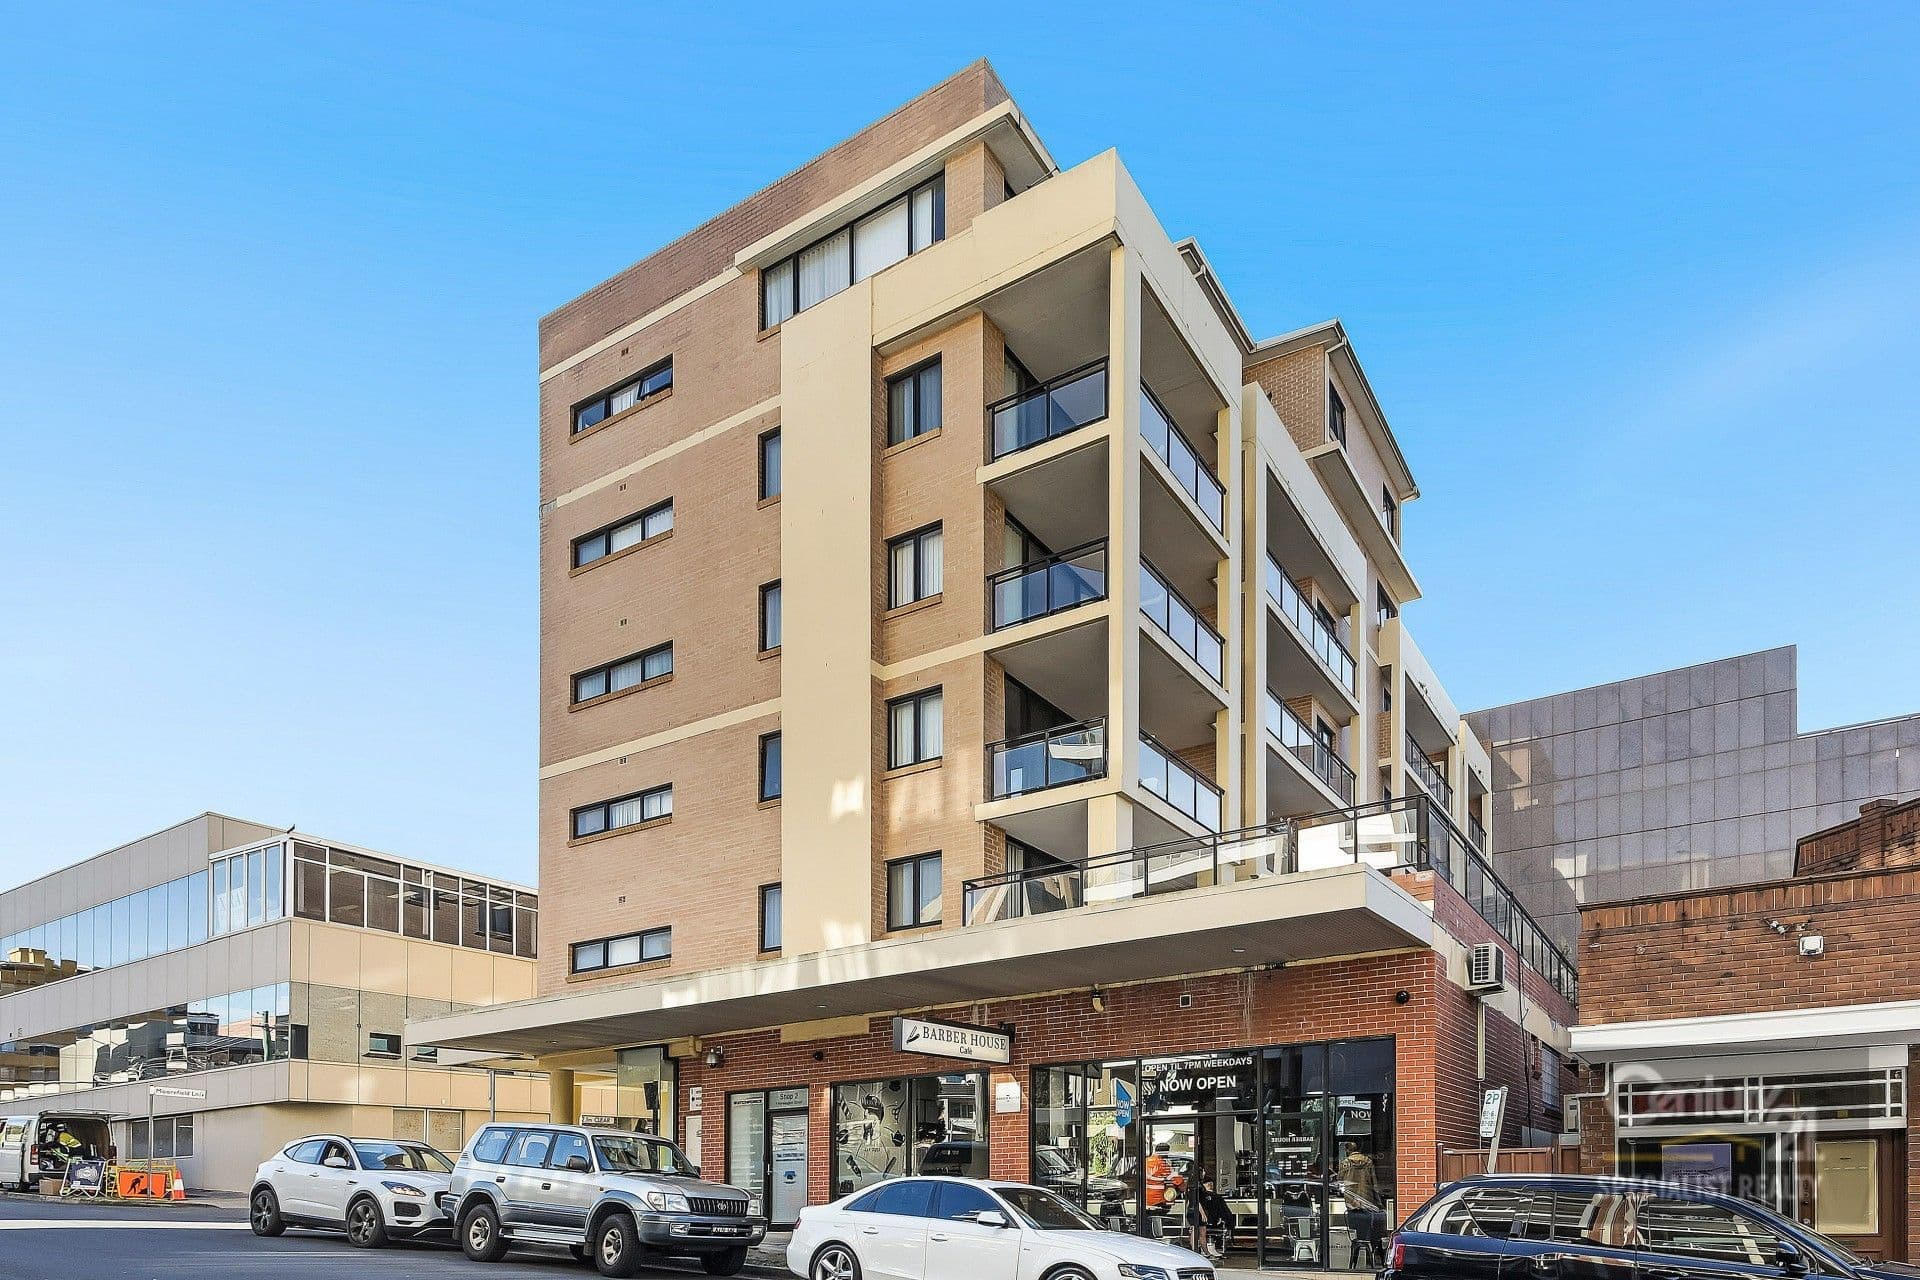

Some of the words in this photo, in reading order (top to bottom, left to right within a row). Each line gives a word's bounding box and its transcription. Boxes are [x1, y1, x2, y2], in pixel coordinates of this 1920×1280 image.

[923, 1026, 967, 1045] BARBER
[970, 1034, 1007, 1050] HOUSE
[1145, 1063, 1168, 1072] OPEN
[1170, 1062, 1182, 1070] TIL
[1184, 1060, 1202, 1069] 7PM
[1203, 1056, 1253, 1068] WEEKDAYS
[1160, 1078, 1193, 1092] NOW
[1196, 1075, 1237, 1090] OPEN
[1485, 1093, 1500, 1105] 2P
